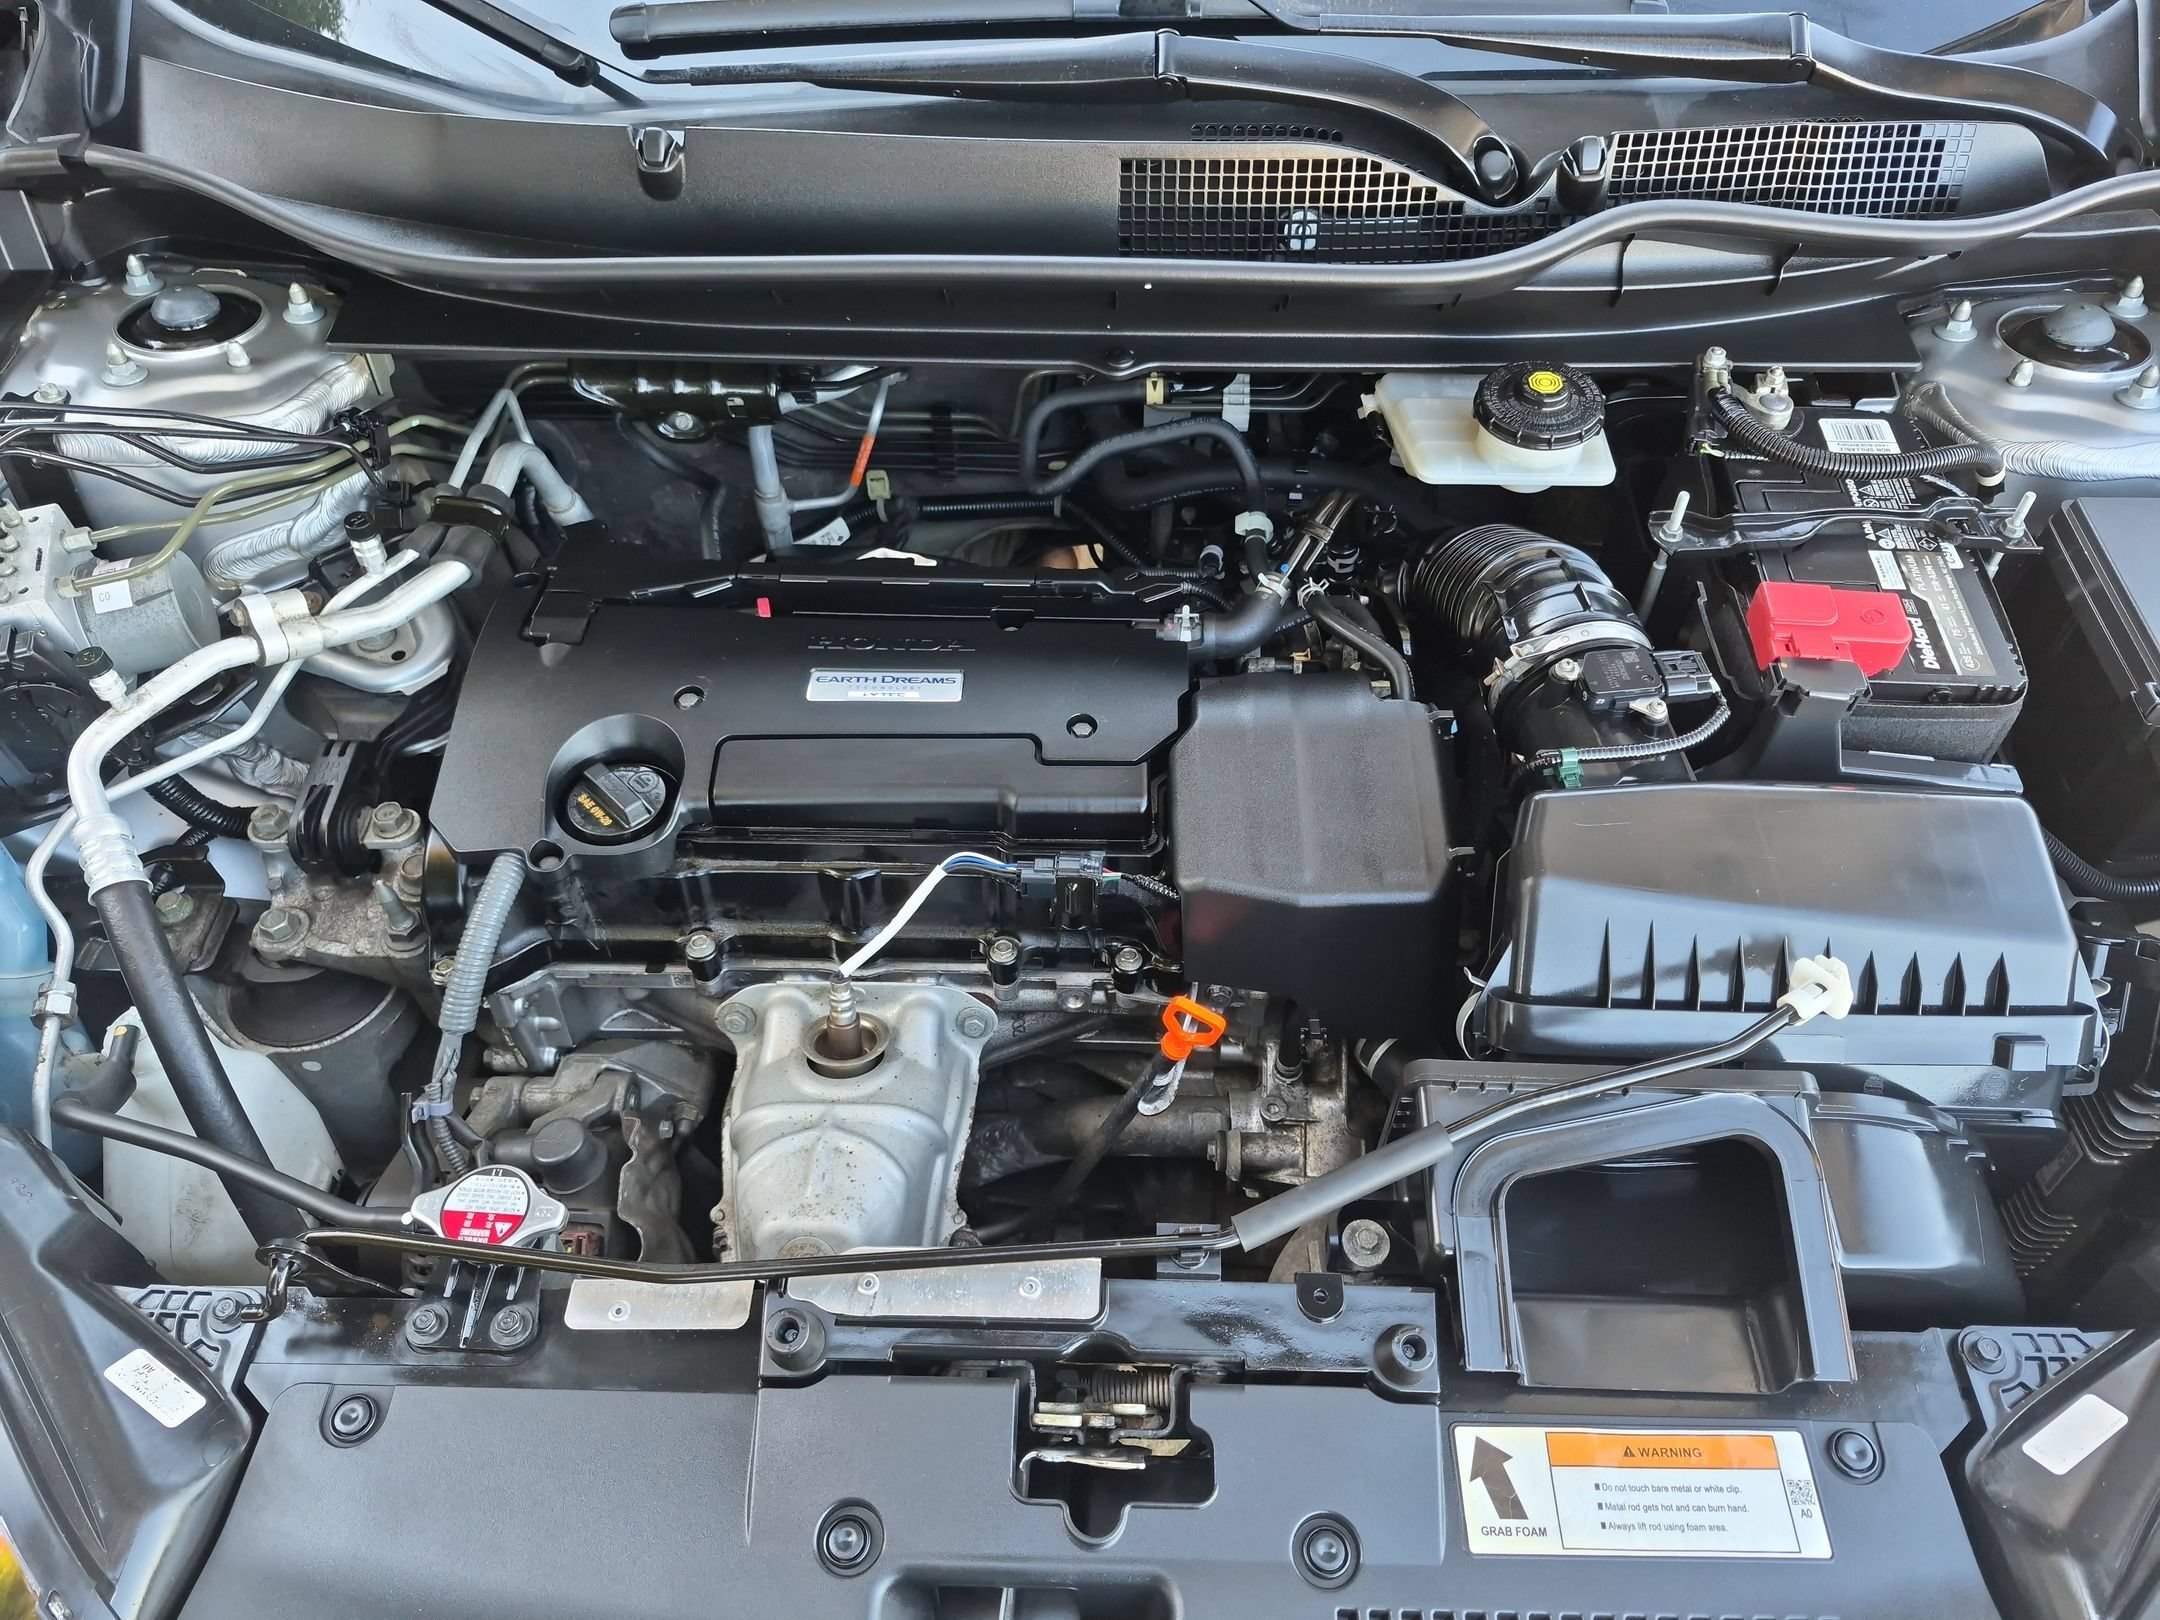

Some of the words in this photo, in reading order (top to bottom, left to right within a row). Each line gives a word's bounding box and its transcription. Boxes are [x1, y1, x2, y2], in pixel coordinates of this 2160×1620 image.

[1905, 555, 1928, 591] PLATINUM
[1906, 617, 1941, 670] DieHard
[815, 676, 877, 684] EARTH
[881, 675, 957, 685] DREAMS
[578, 792, 596, 810] SAE
[590, 806, 613, 826] 0W-20
[1638, 1447, 1702, 1458] WARNING
[1602, 1483, 1613, 1492] Do
[1614, 1483, 1627, 1493] not
[1628, 1484, 1650, 1493] touch
[1651, 1484, 1669, 1493] bare
[1671, 1485, 1692, 1494] metal
[1694, 1486, 1702, 1494] or
[1704, 1485, 1725, 1494] white
[1726, 1485, 1742, 1495] clip.
[1605, 1502, 1627, 1511] Metal
[1628, 1503, 1641, 1511] rod
[1643, 1504, 1659, 1513] gets
[1661, 1503, 1674, 1512] hot
[1675, 1504, 1690, 1512] and
[1692, 1505, 1707, 1513] can
[1708, 1504, 1726, 1513] burn
[1727, 1504, 1750, 1513] hand.
[1481, 1526, 1513, 1537] GRAB
[1515, 1526, 1548, 1537] FOAM
[1608, 1522, 1637, 1532] Always
[1638, 1522, 1647, 1531] lift
[1649, 1522, 1662, 1531] rod
[1664, 1523, 1685, 1533] using
[1686, 1523, 1707, 1532] foam
